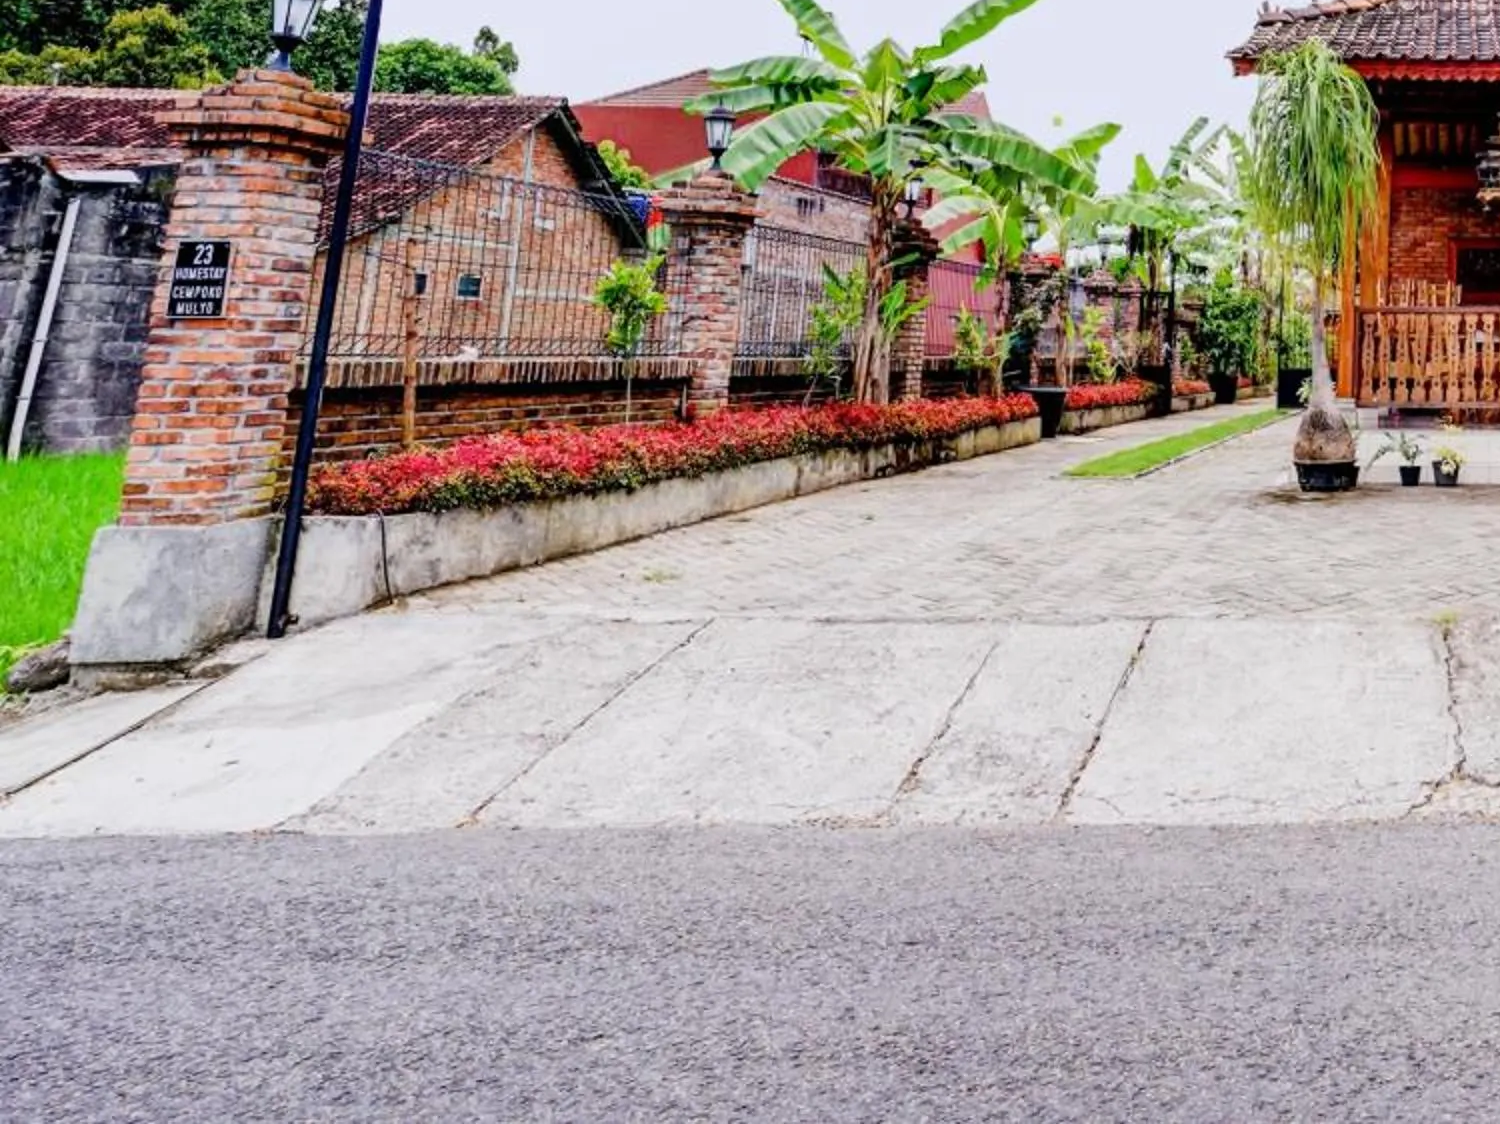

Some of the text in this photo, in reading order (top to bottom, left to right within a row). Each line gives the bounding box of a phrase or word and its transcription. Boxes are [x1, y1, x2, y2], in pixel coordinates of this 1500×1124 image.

[193, 244, 215, 265] 23
[175, 267, 226, 280] HOMESTAY
[172, 285, 222, 299] CEMPOKO
[176, 302, 214, 315] MULYO
